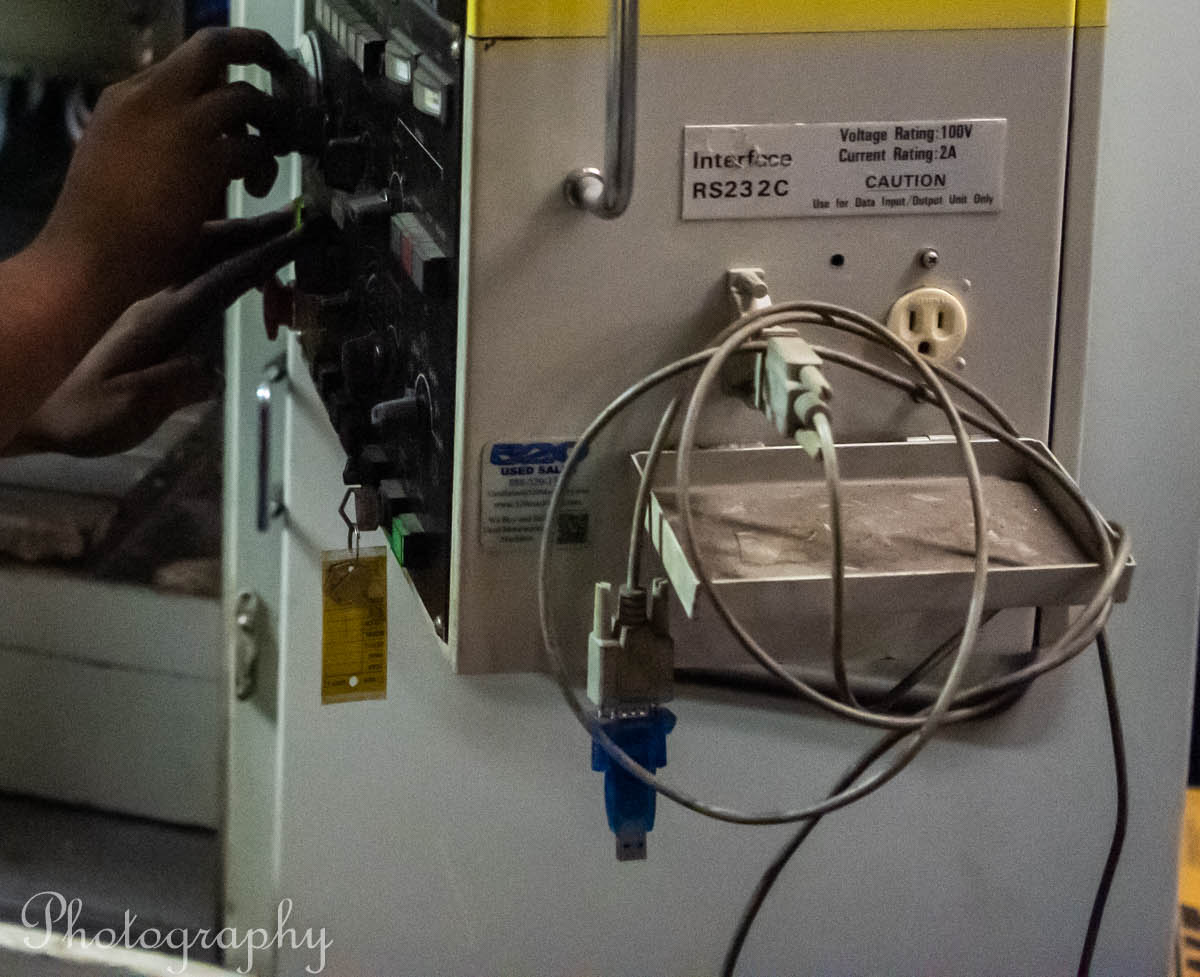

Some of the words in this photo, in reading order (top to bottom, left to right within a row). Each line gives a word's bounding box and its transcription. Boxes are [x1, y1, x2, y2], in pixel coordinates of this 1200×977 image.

[840, 127, 887, 143] Voltage
[693, 150, 793, 169] Interface
[839, 147, 886, 163] Current
[692, 179, 789, 199] RS232C
[865, 173, 947, 189] CAUTION
[813, 198, 830, 209] Use
[836, 198, 849, 209] for
[855, 197, 876, 208] Data
[949, 195, 968, 205] Unit
[973, 195, 995, 206] Only
[500, 466, 534, 477] USED
